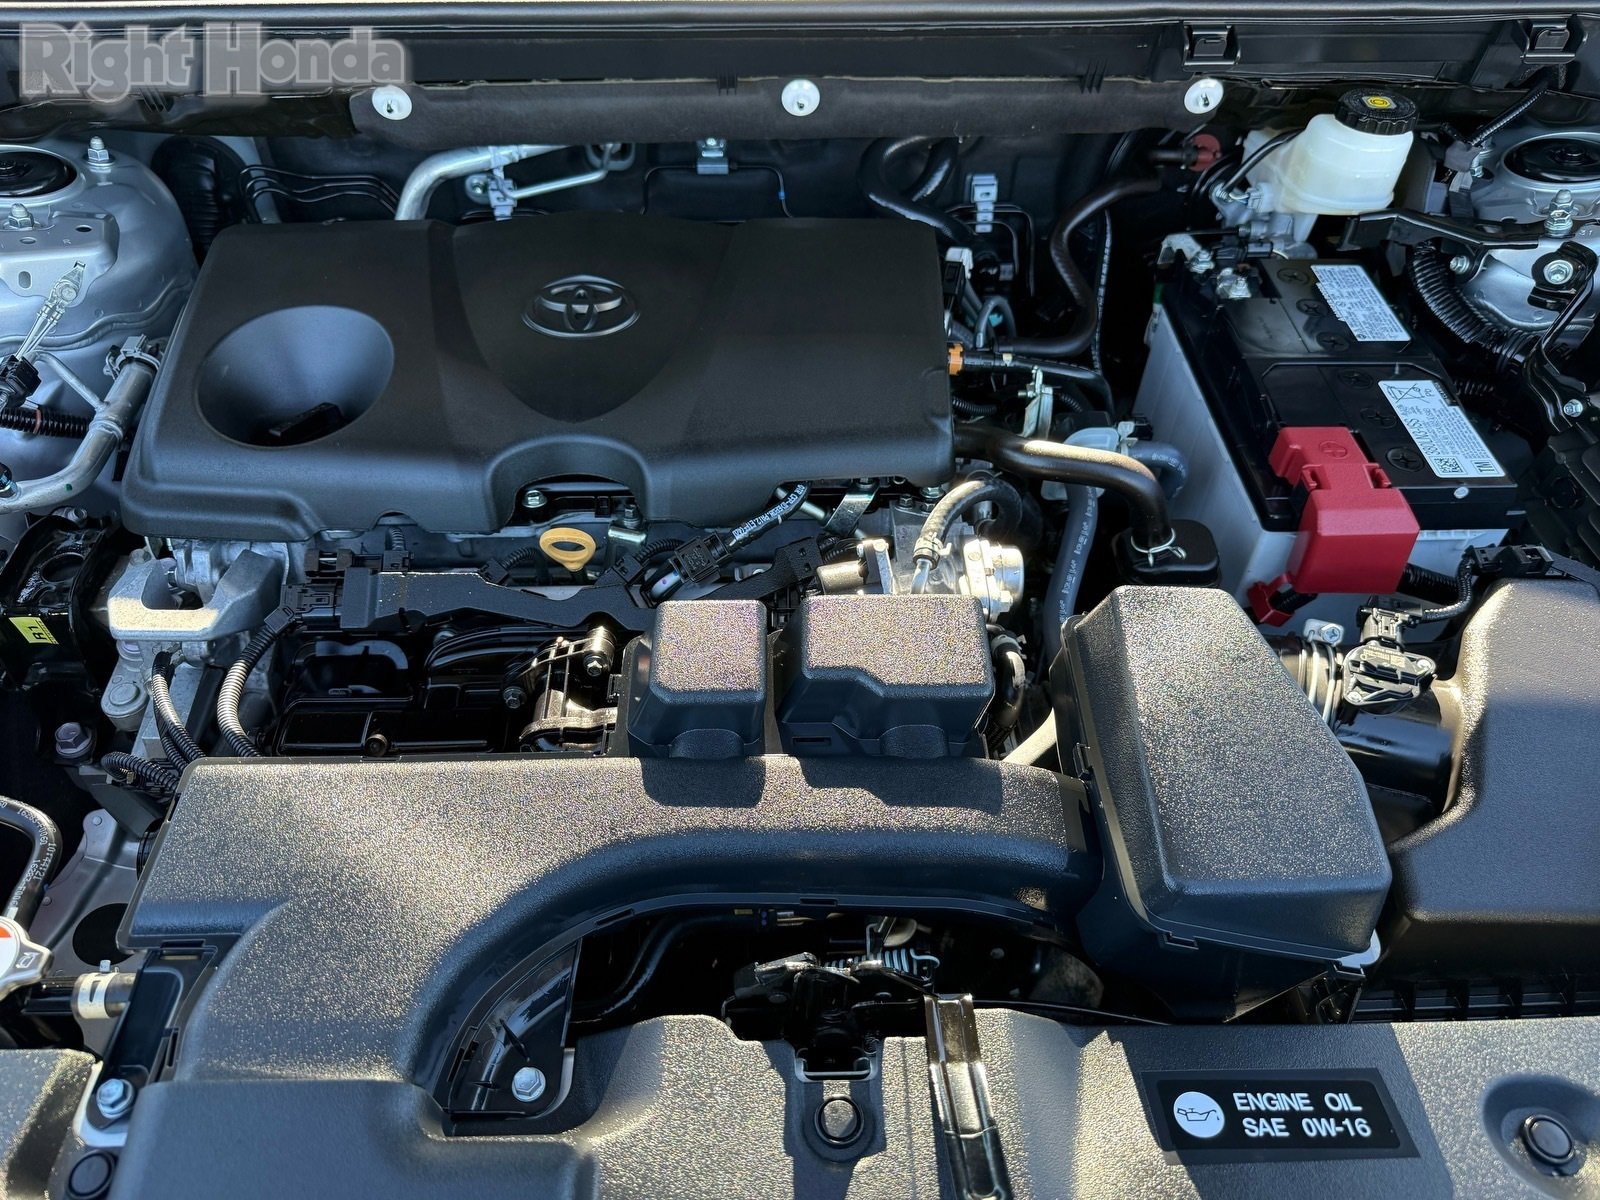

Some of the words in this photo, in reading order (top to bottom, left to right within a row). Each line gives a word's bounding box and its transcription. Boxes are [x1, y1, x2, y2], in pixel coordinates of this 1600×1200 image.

[1232, 1092, 1314, 1111] ENGINE
[1324, 1092, 1363, 1111] OIL
[1242, 1117, 1290, 1137] SAE
[1301, 1117, 1372, 1137] 0W-16
